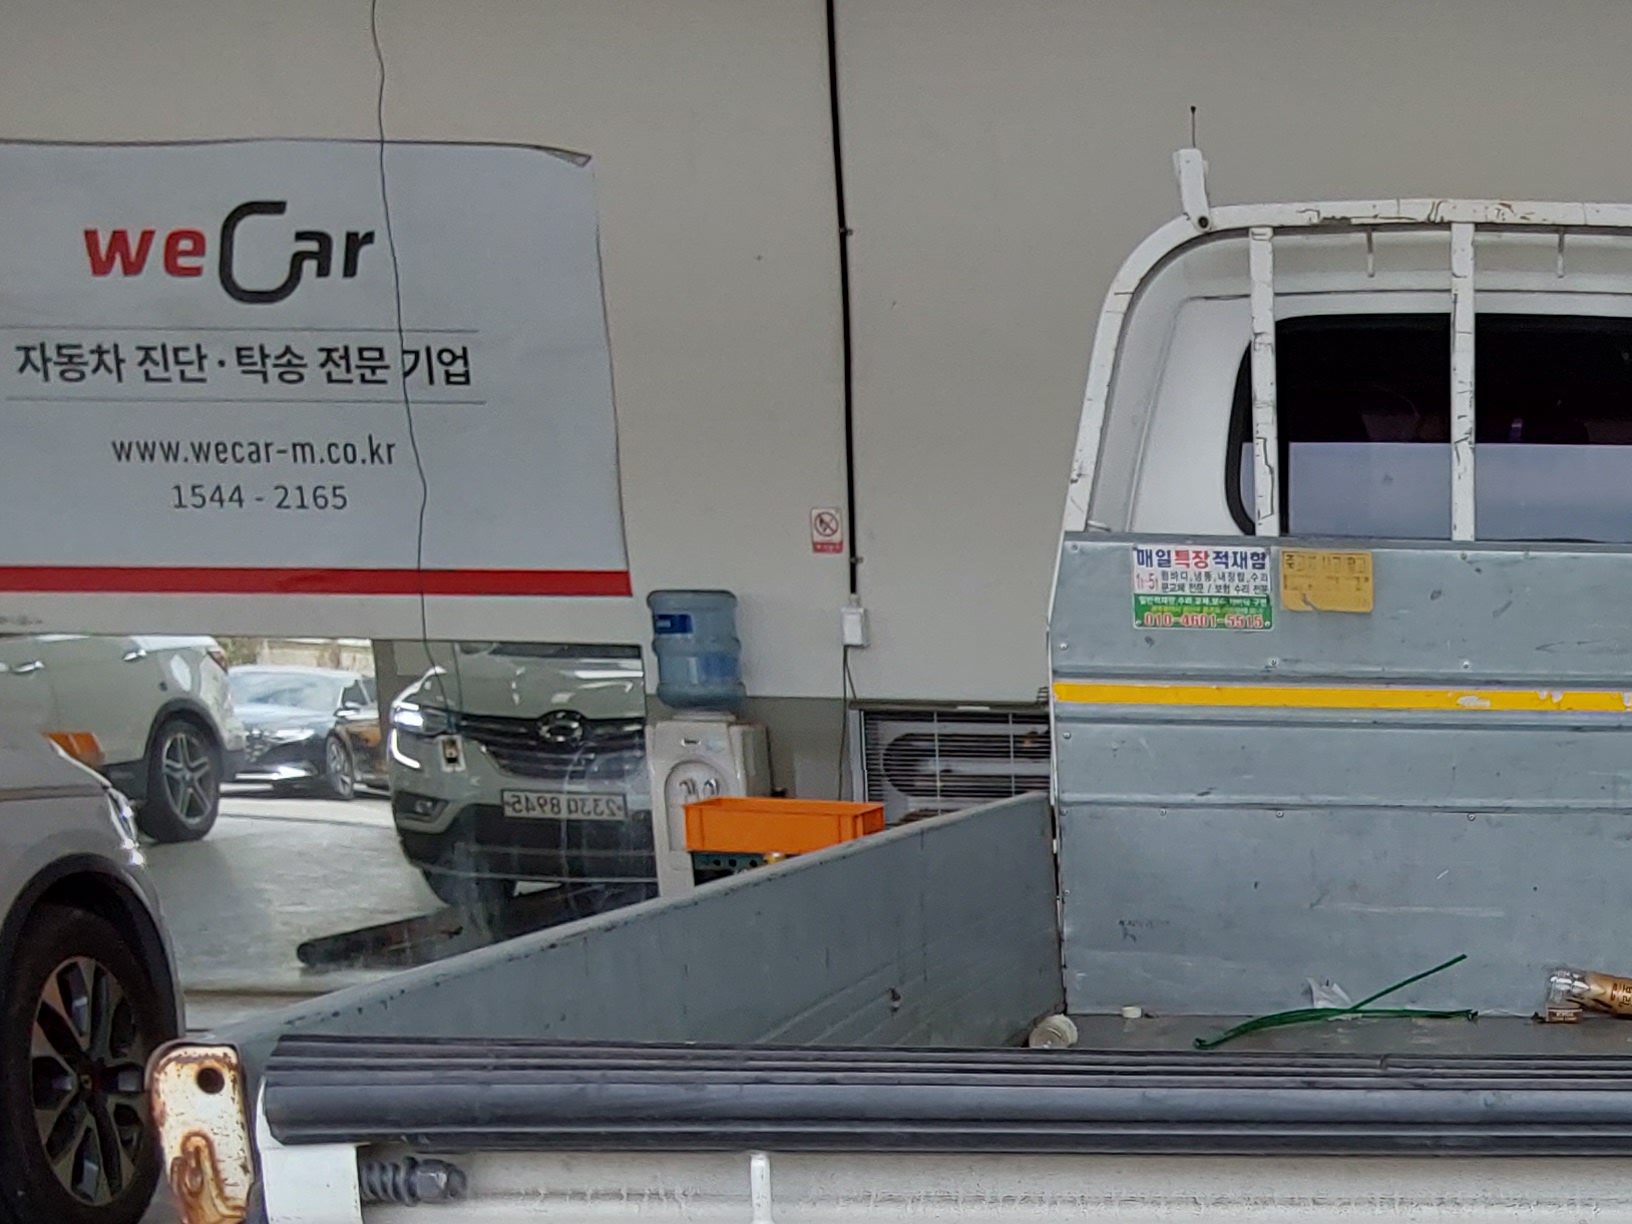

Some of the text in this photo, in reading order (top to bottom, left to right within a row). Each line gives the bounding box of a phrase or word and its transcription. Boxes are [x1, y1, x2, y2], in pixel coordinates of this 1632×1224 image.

[15, 342, 126, 383] 자동차
[318, 345, 391, 385] 전문
[402, 346, 472, 386] 기업
[111, 434, 396, 465] www.wecar-m.co.kr
